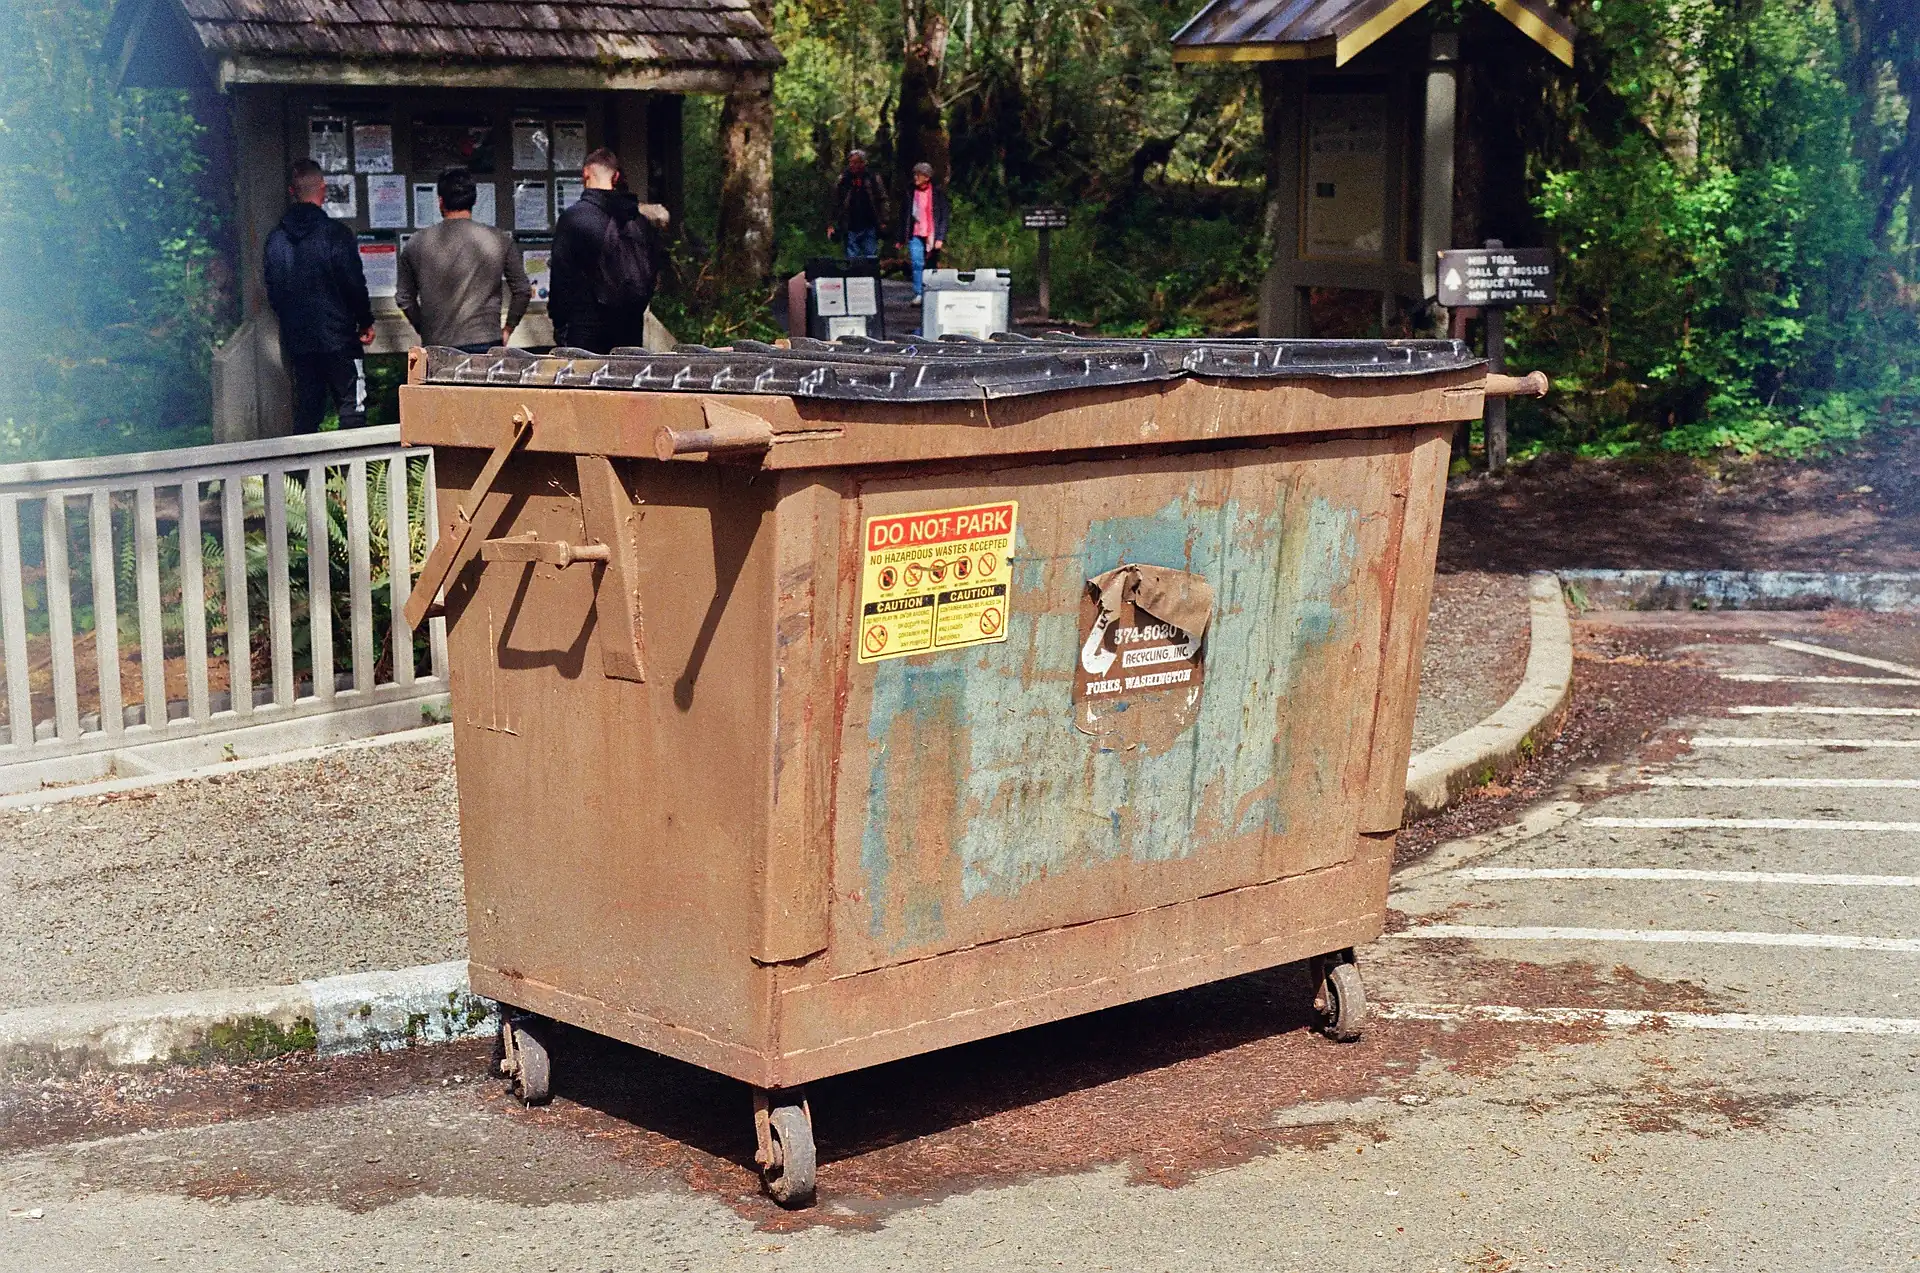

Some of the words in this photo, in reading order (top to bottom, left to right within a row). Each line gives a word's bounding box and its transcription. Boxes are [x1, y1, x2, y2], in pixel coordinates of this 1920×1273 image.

[1491, 255, 1517, 264] TRAIL
[1467, 268, 1493, 277] HALL
[1497, 266, 1510, 276] OF
[1513, 266, 1550, 275] MOSSES
[1467, 278, 1504, 289] SPRUCE
[1508, 278, 1534, 287] TRAIL
[1491, 290, 1517, 299] RIVER
[1522, 290, 1548, 298] TRAIL
[874, 523, 904, 546] DO
[910, 517, 951, 541] NOT
[956, 510, 1008, 535] PARK
[870, 554, 882, 565] NO
[885, 548, 933, 563] HAZARDOUS
[936, 544, 967, 556] WASTES
[969, 538, 1008, 552] ACCEPTED
[950, 587, 995, 602] CAUTION
[877, 597, 923, 613] CAUTION
[1086, 679, 1122, 695] FORKS,
[1125, 669, 1192, 689] WASHINGTON
